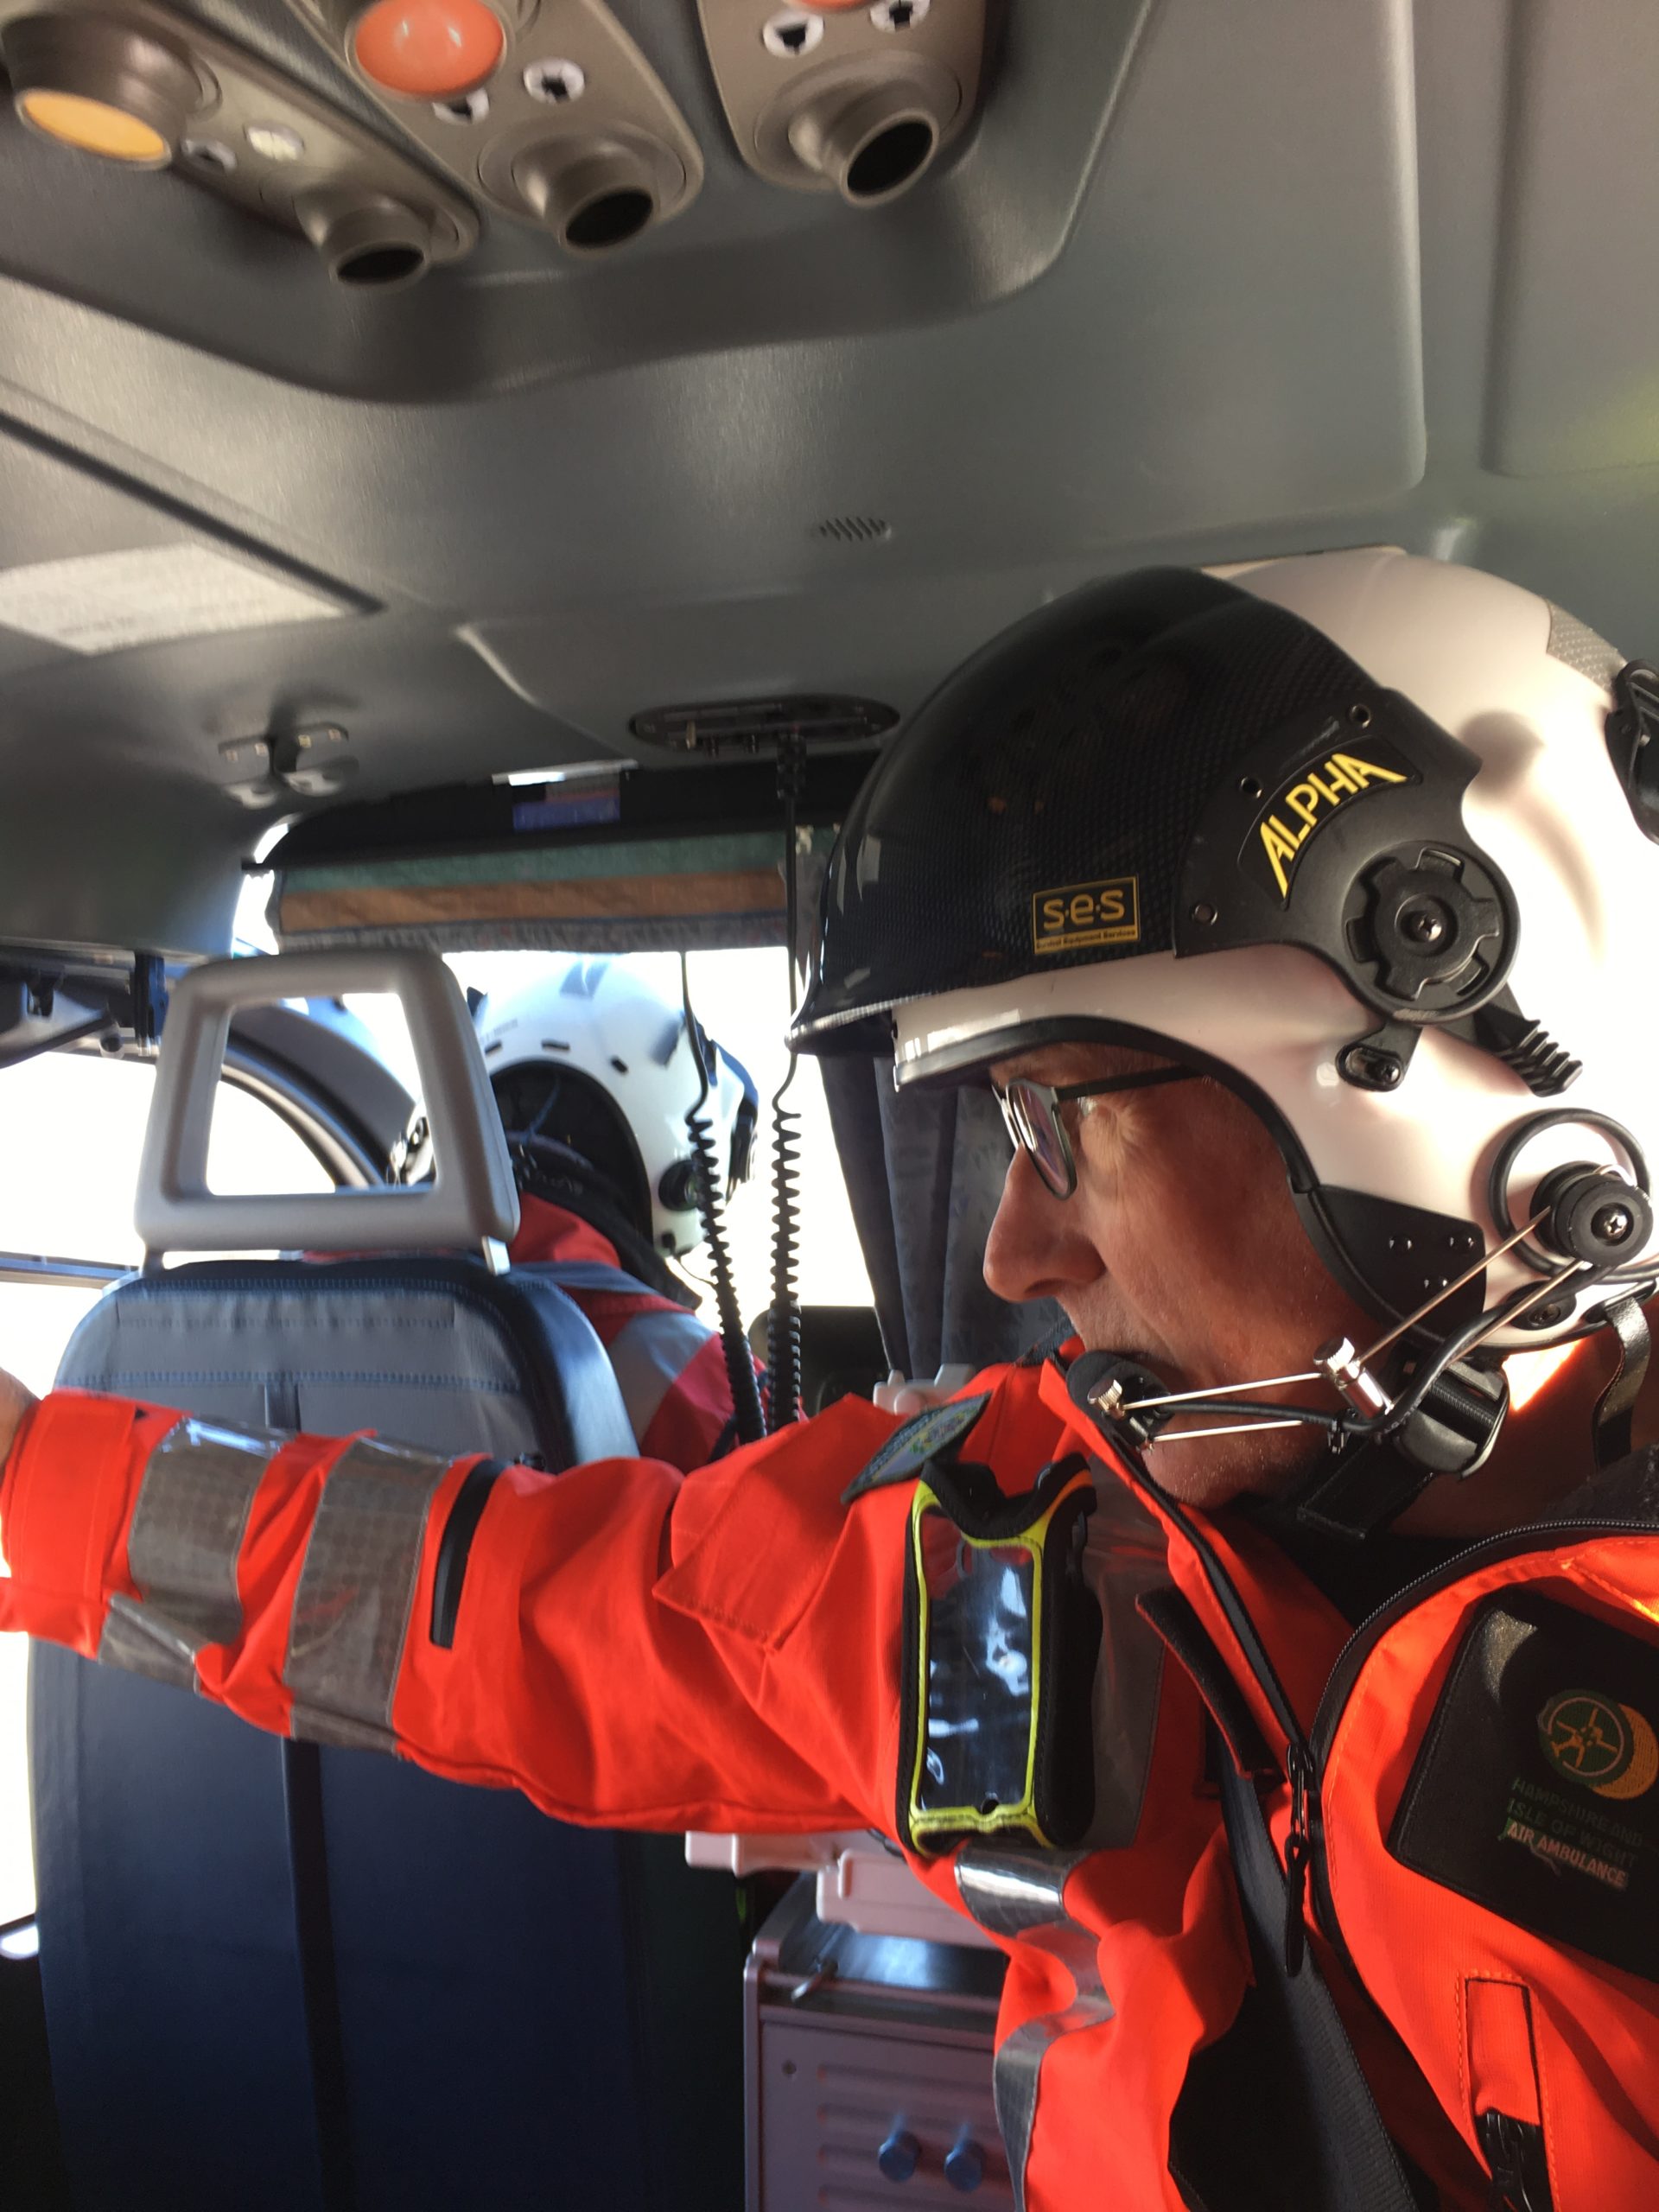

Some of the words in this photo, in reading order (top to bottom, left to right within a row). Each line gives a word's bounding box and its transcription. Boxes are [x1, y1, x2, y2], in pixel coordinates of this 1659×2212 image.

[1260, 753, 1408, 899] ALPHA
[1507, 1798, 1548, 1828] ISLE
[1550, 1818, 1577, 1838] OF
[1580, 1832, 1639, 1867] WIGHT
[1511, 1777, 1611, 1831] HAMPSHIRE
[1610, 1822, 1643, 1847] AND
[1507, 1819, 1535, 1843] AIR
[1538, 1834, 1629, 1887] AMBULANCE
